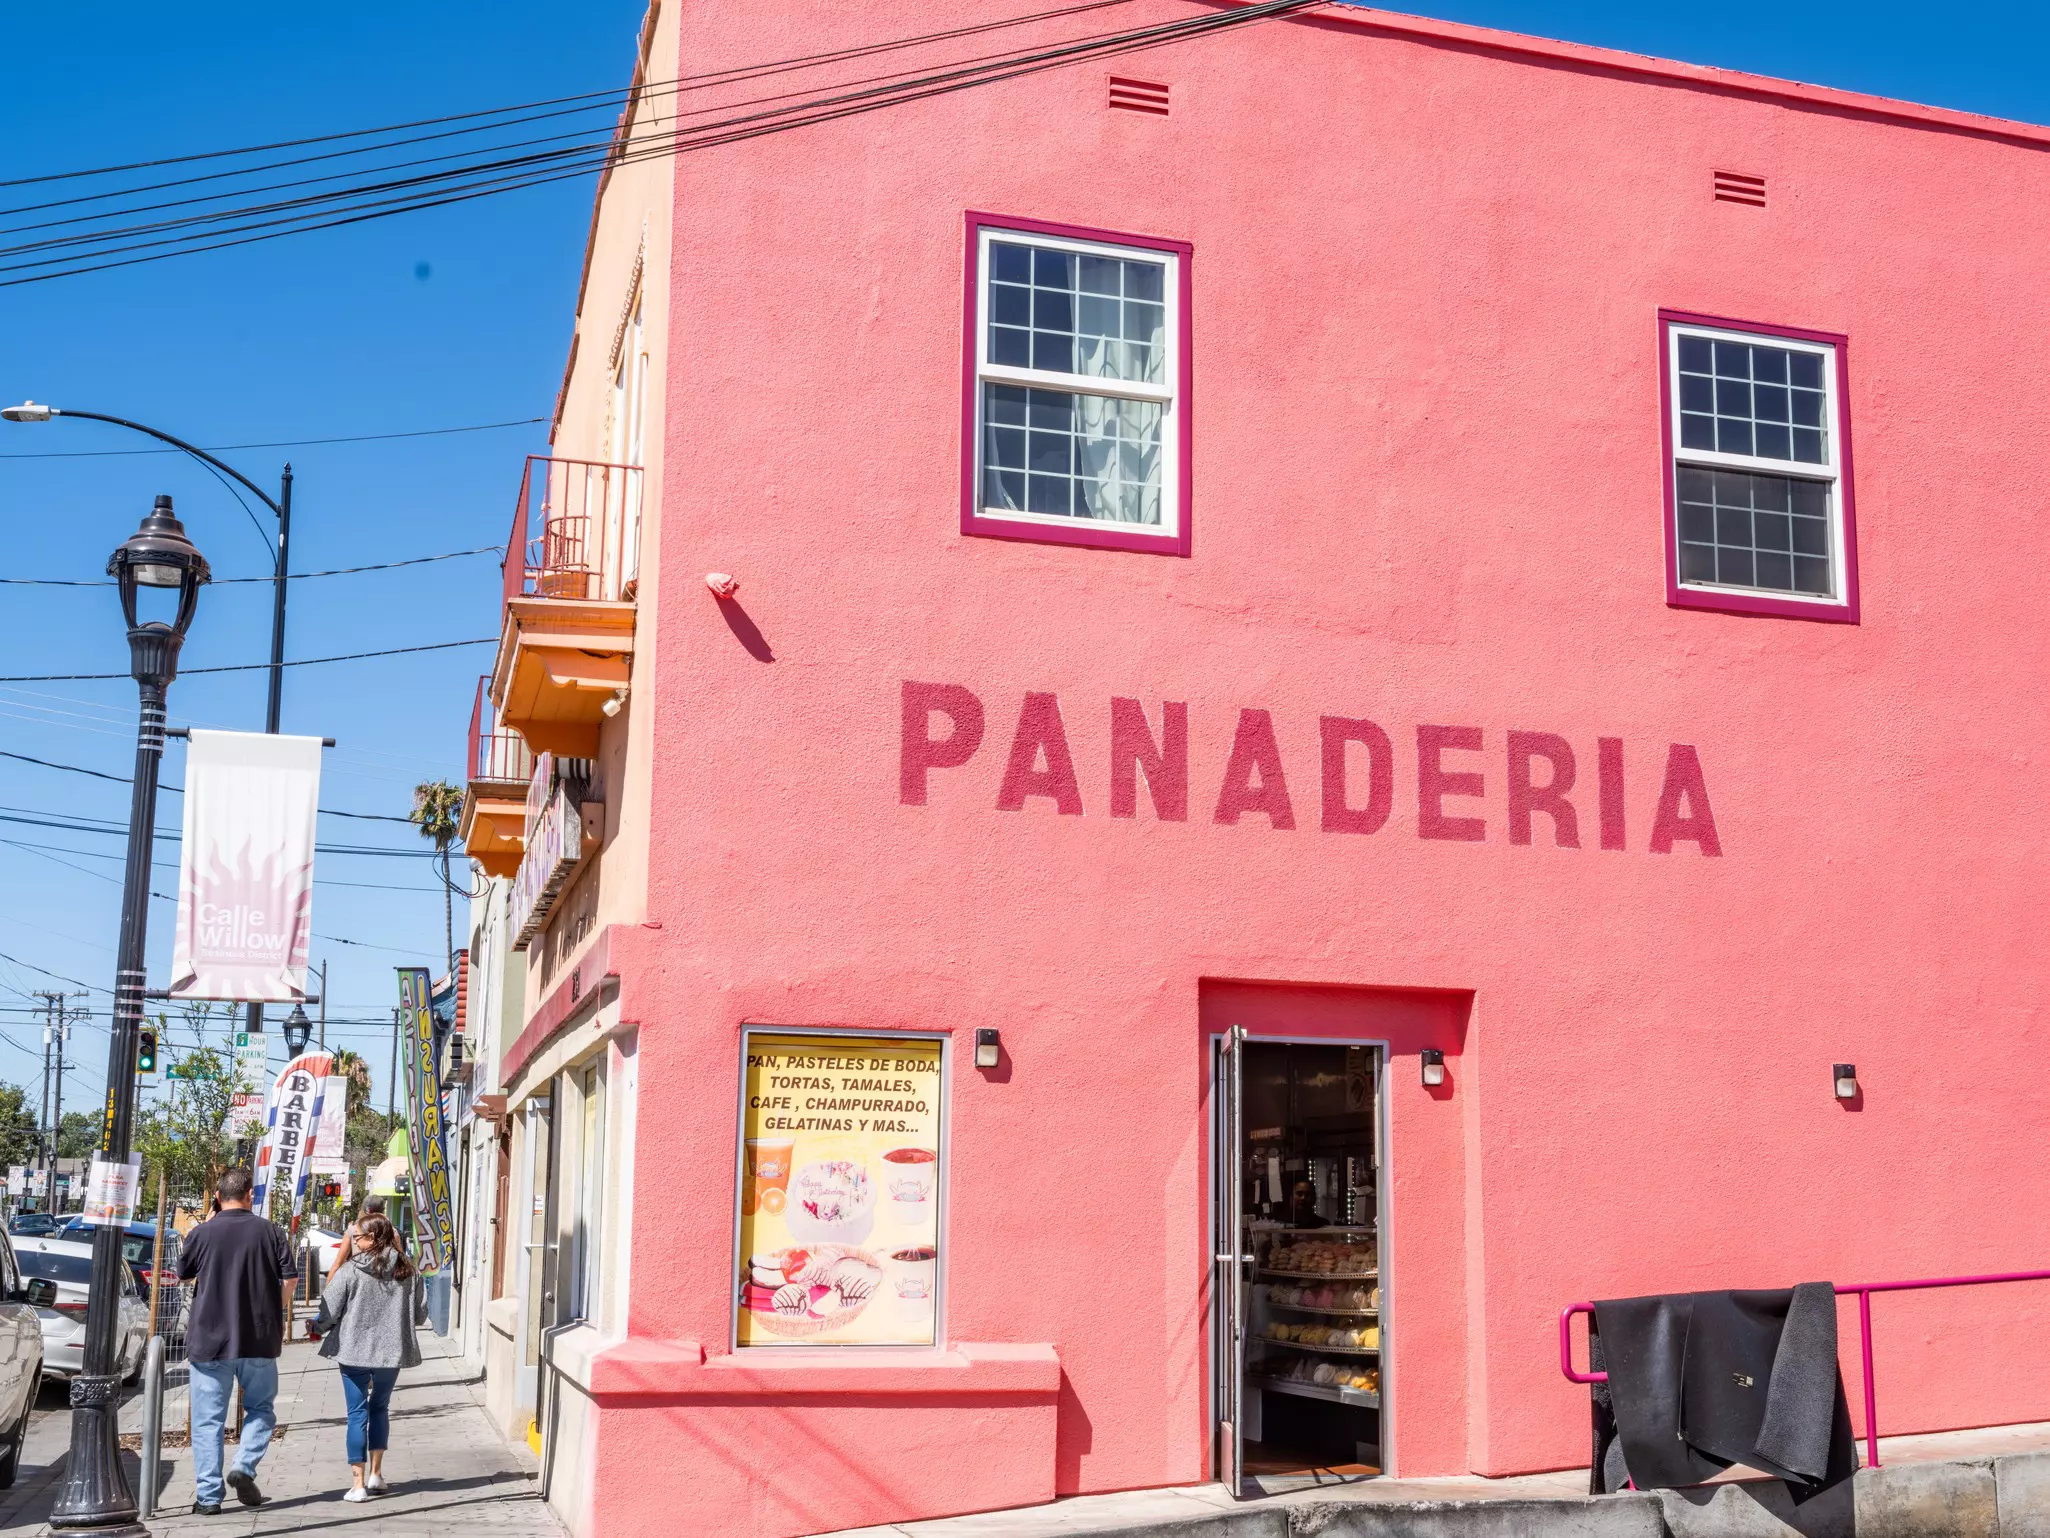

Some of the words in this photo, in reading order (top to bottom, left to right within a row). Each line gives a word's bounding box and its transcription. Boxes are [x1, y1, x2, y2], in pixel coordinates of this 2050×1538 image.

[898, 680, 1723, 857] PANADERIA
[199, 903, 265, 926] Calle
[199, 925, 287, 949] Willow
[248, 950, 282, 959] District
[236, 1049, 265, 1059] PARKING
[747, 1055, 781, 1071] PAN,
[786, 1056, 865, 1071] PASTELES
[870, 1059, 890, 1071] DE
[894, 1060, 940, 1075] BODA,
[770, 1076, 835, 1092] TORTAS,
[842, 1078, 916, 1095] TAMALES,
[234, 1094, 246, 1105] NO
[805, 1097, 929, 1115] CHAMPURRADO,
[275, 1075, 310, 1184] BARBER
[765, 1117, 853, 1132] GELATINAS
[859, 1119, 869, 1131] Y
[872, 1119, 919, 1133] MAS...
